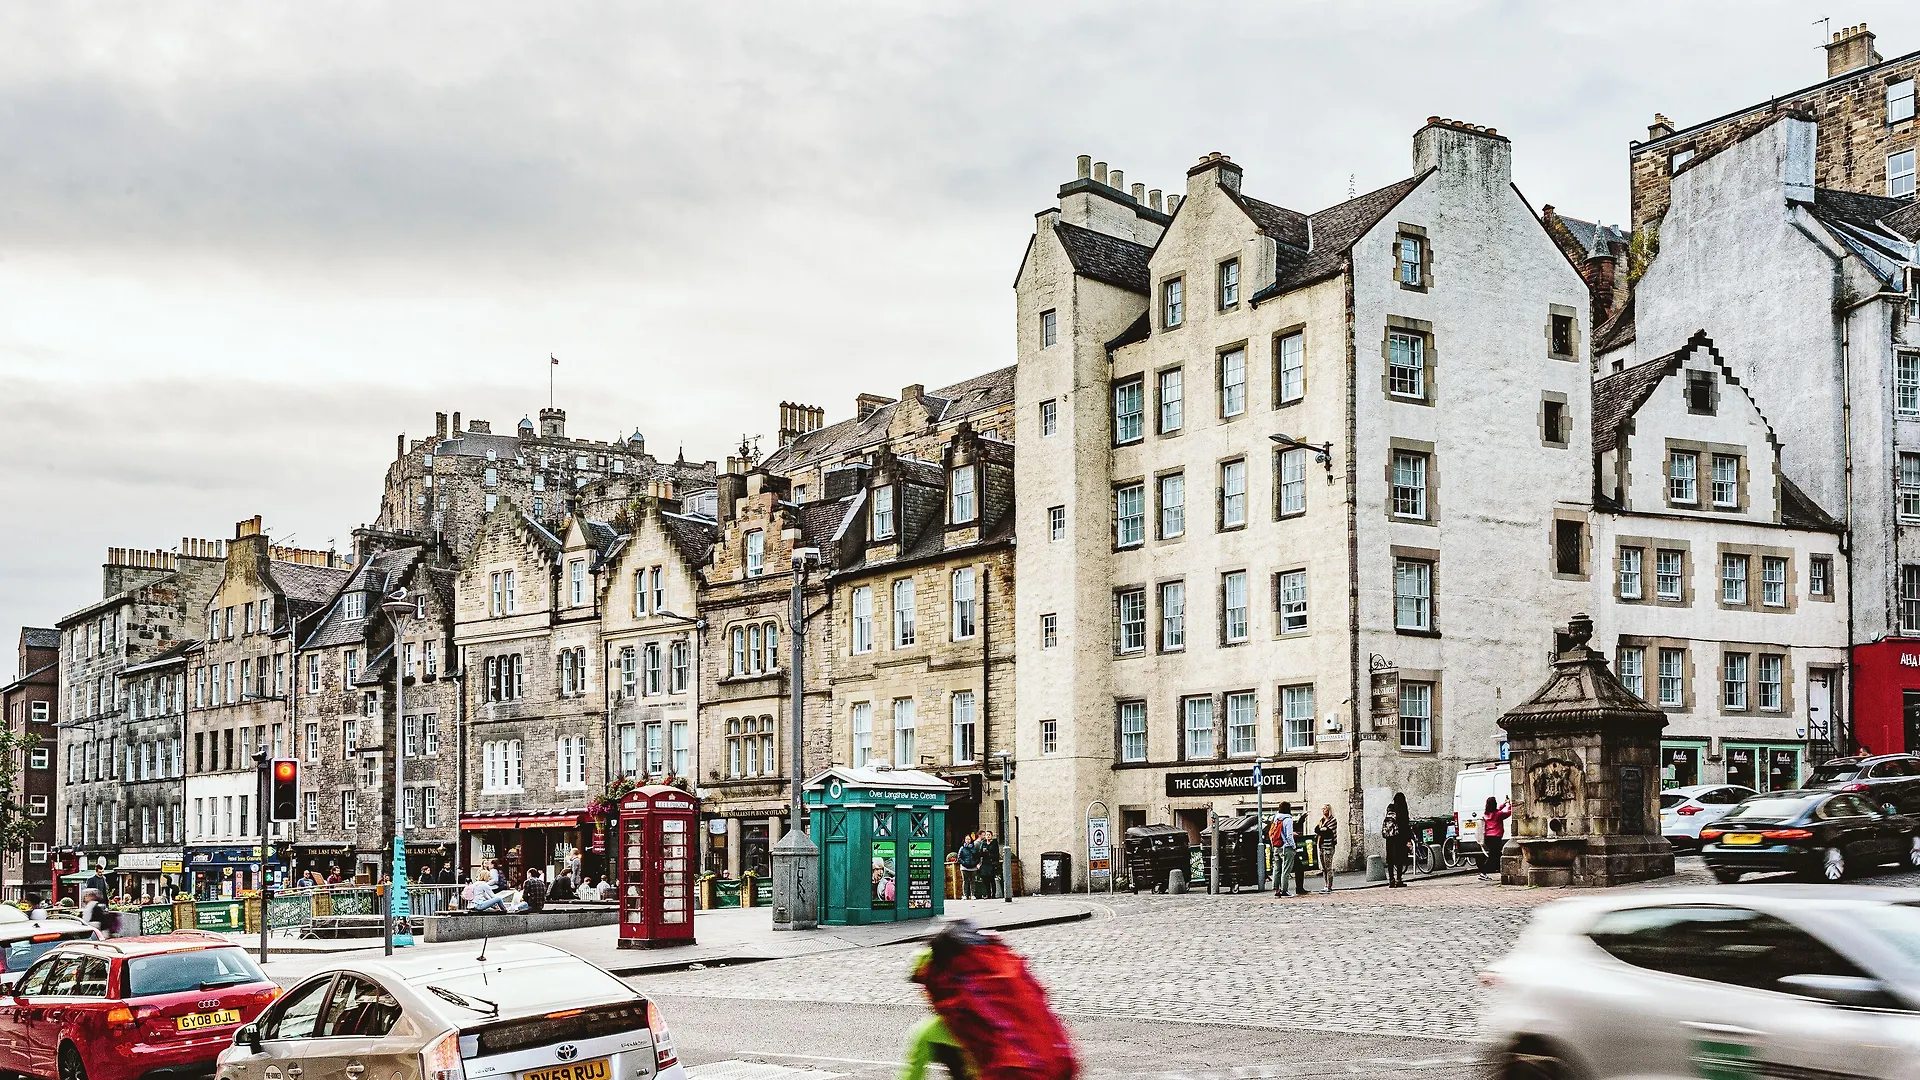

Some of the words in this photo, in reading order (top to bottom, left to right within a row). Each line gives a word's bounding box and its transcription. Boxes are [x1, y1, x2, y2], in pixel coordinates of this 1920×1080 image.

[1900, 652, 1920, 667] AHA
[1175, 779, 1191, 790] THE
[1192, 777, 1254, 789] GRASSMARKET
[869, 790, 883, 798] Over
[884, 790, 910, 800] Langshaw
[910, 791, 919, 799] Ice
[920, 792, 937, 800] Cream
[182, 1014, 212, 1028] GY08
[214, 1011, 236, 1024] OJL
[574, 1062, 605, 1080] RUJ
